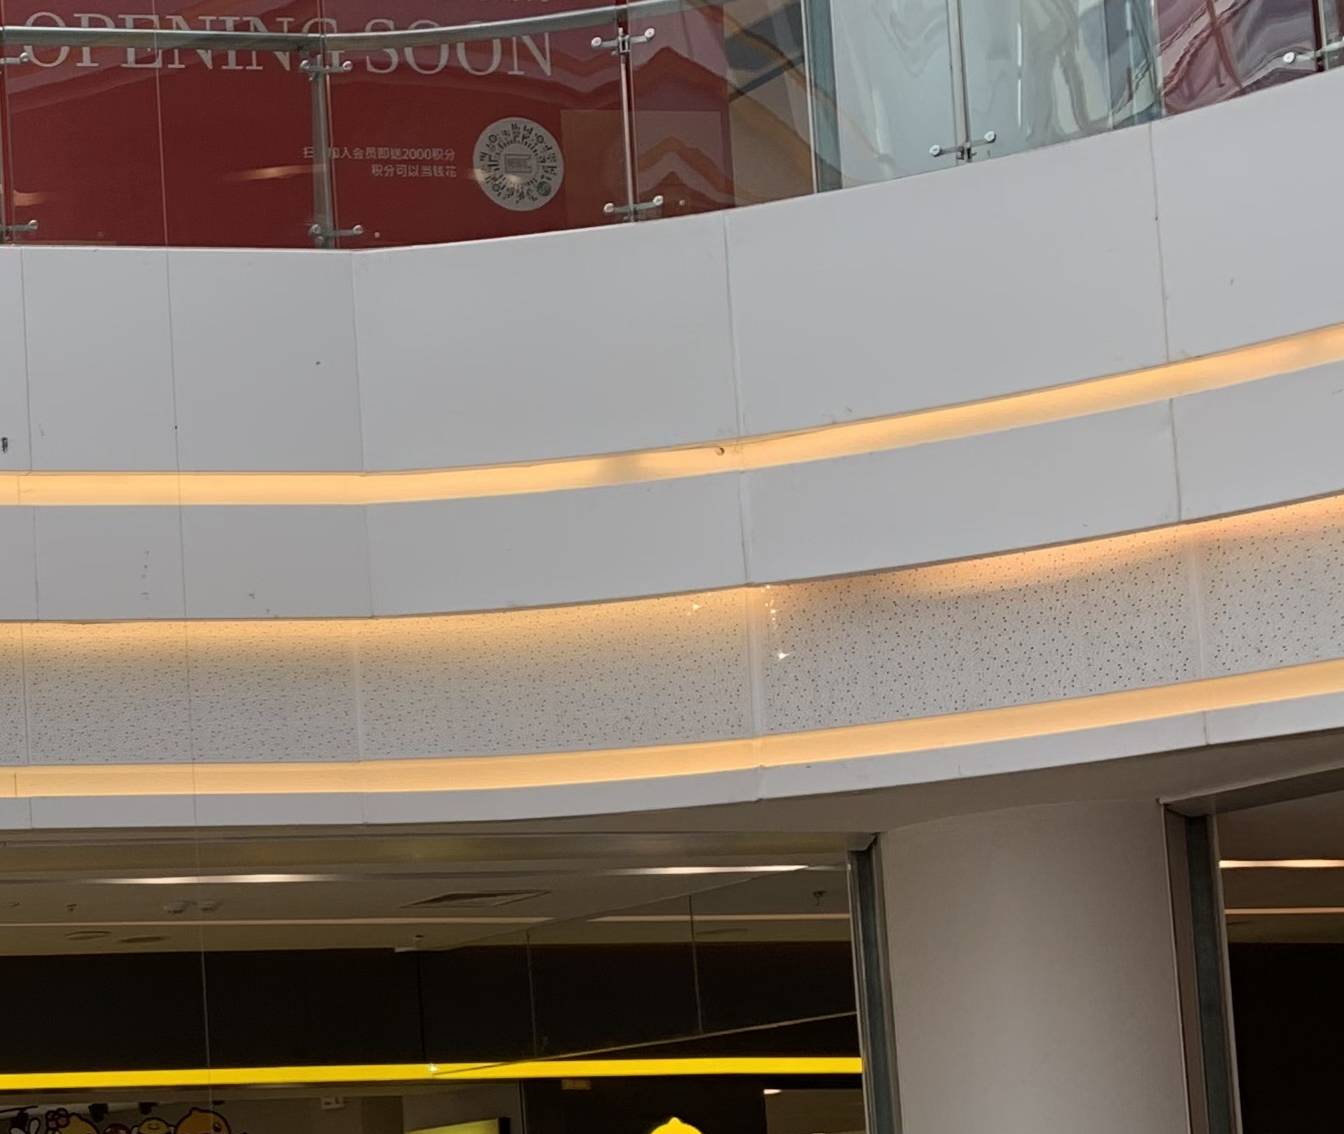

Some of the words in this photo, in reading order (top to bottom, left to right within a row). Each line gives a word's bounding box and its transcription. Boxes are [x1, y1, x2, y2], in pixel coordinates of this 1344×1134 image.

[365, 18, 554, 77] SOON
[303, 146, 456, 161] 扫加入会员即送2000积分
[371, 163, 457, 178] 积分可以当钱花
